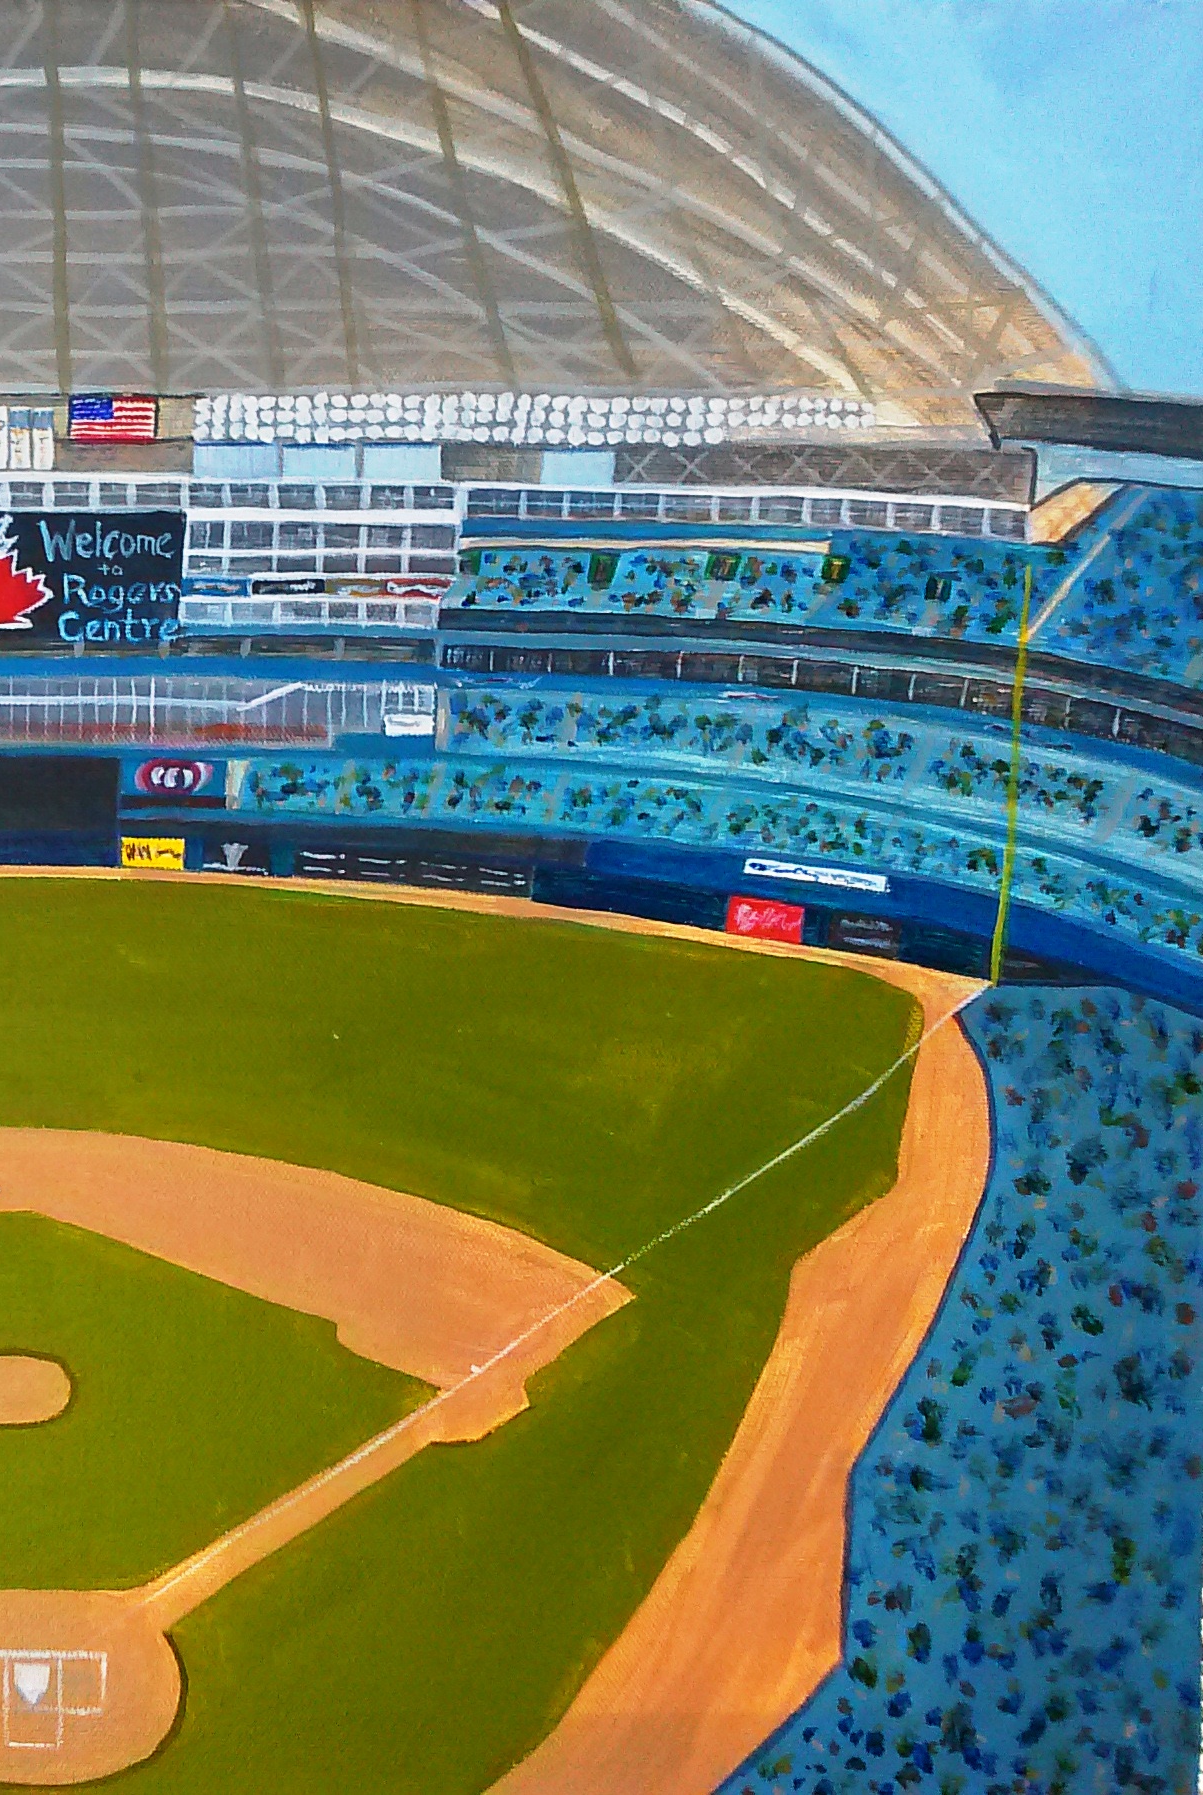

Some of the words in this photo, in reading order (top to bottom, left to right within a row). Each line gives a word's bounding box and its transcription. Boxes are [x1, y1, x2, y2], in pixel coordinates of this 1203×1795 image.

[37, 519, 175, 562] Welcome
[97, 563, 124, 576] to
[63, 573, 182, 614] Rogers
[58, 608, 182, 644] Centre
